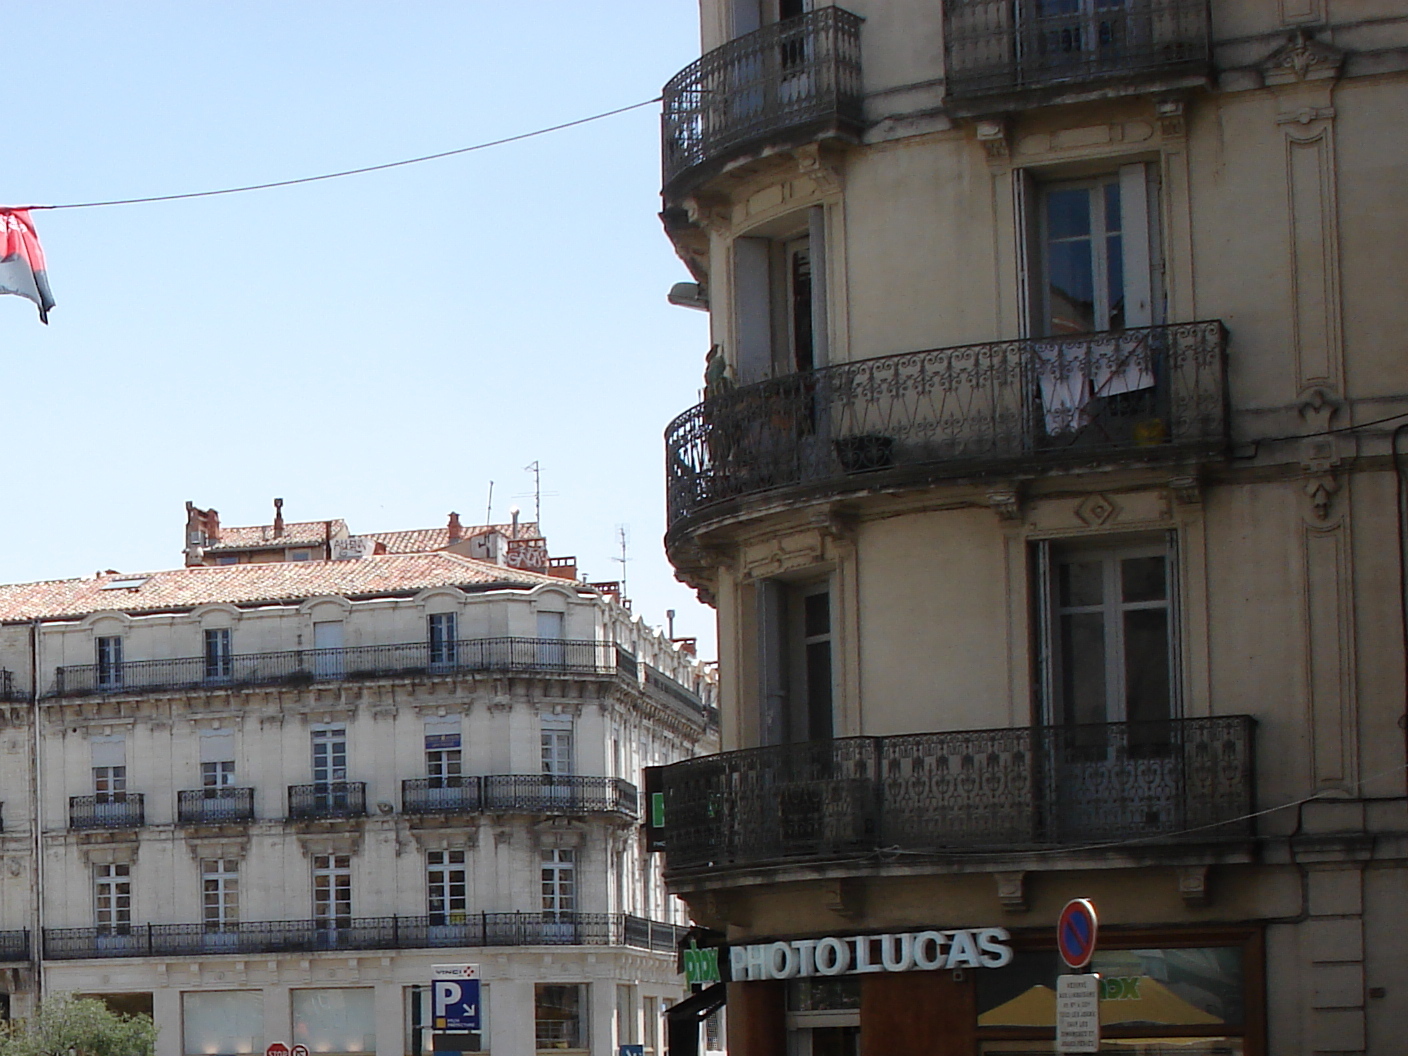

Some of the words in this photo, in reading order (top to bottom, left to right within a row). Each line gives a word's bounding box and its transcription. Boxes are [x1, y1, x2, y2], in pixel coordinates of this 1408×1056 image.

[729, 937, 852, 982] PHOTO
[855, 926, 1015, 974] LUCAS
[435, 981, 462, 1017] P
